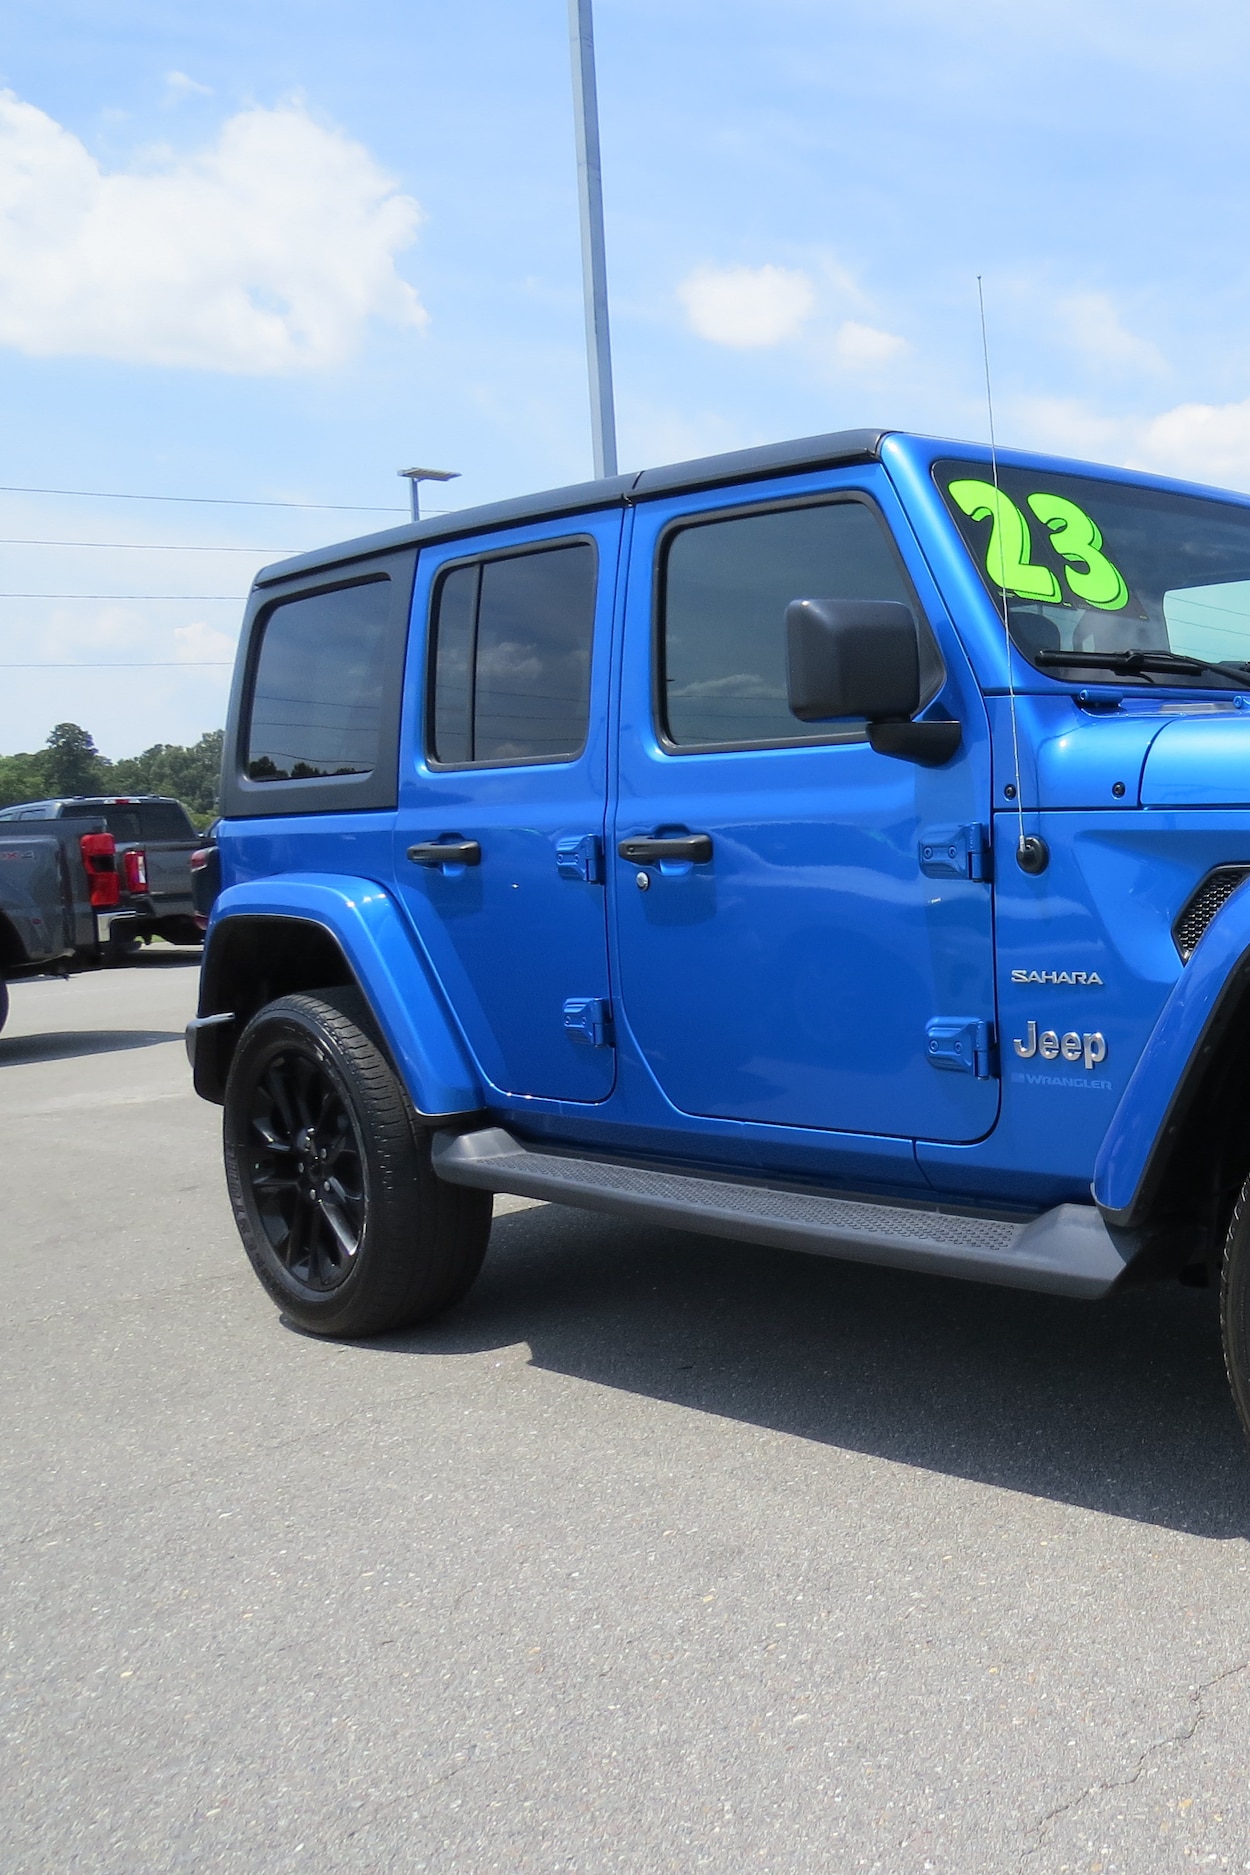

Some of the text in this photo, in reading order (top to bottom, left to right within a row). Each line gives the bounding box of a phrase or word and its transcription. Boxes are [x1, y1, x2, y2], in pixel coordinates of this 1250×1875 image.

[947, 479, 1129, 610] 23
[1011, 969, 1104, 986] SAHARA
[1013, 1020, 1108, 1070] Jeep
[1026, 1074, 1113, 1091] WRANGLER
